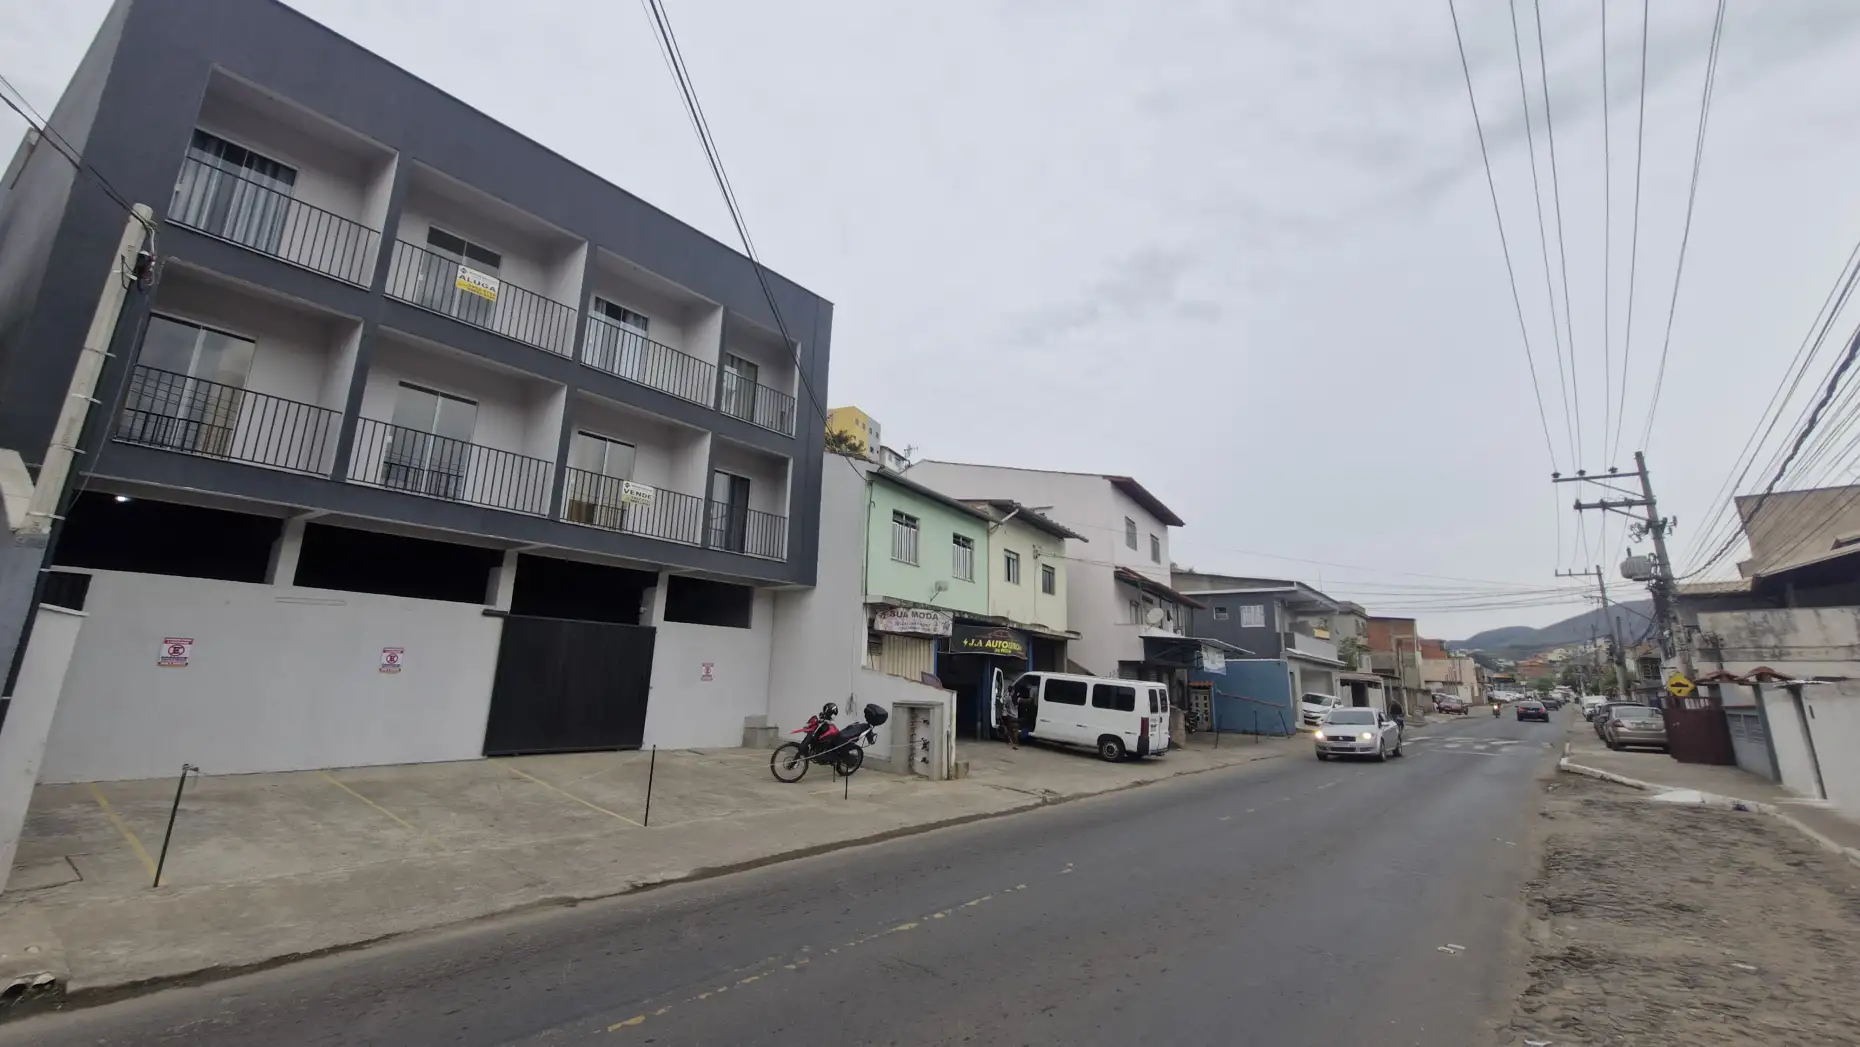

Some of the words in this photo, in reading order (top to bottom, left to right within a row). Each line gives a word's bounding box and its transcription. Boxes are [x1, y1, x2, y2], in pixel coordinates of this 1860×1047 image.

[459, 274, 496, 292] ALUGA
[623, 488, 653, 500] VENDE
[889, 610, 909, 618] SUA
[911, 610, 939, 620] MODA
